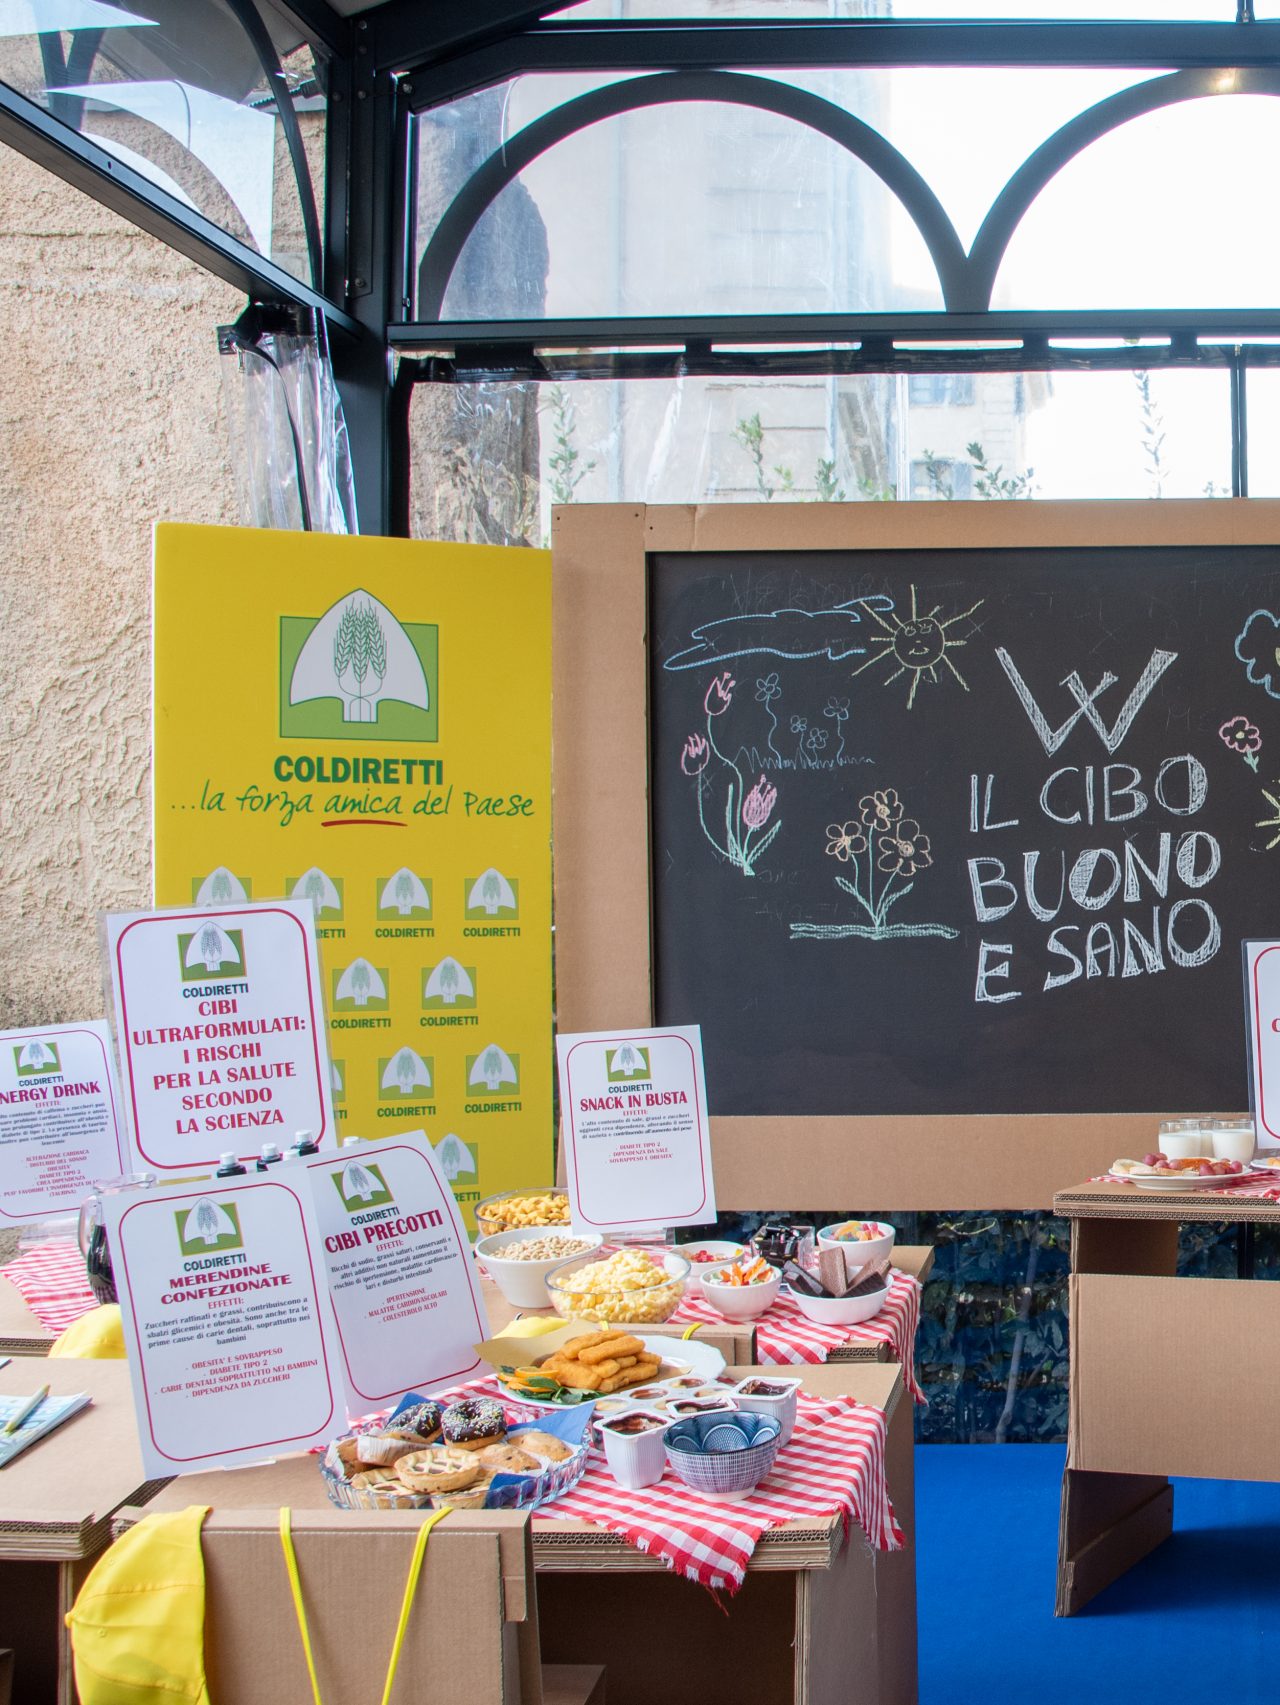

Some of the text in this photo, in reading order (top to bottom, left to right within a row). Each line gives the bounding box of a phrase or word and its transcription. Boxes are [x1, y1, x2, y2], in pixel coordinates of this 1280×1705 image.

[995, 647, 1178, 758] W
[273, 755, 444, 785] COLDIRETTI
[970, 753, 1208, 832] IL CIBO
[236, 784, 314, 827] forza
[324, 788, 403, 815] amica
[413, 784, 453, 815] del
[463, 791, 535, 817] Paese
[967, 830, 1220, 923] BUONO
[375, 927, 435, 938] COLDIRETTI
[463, 927, 521, 937] COLDIRETTI
[975, 898, 1221, 1003] E SANO
[183, 983, 249, 998] COLDIRETTI
[198, 999, 237, 1016] CIBI
[133, 1016, 306, 1046] ULTRAFORMULATI:
[331, 1018, 391, 1029] COLDIRETTI
[420, 1015, 479, 1027] COLDIRETTI
[183, 1043, 262, 1064] I RISCHI
[19, 1075, 64, 1087] COLDIRETTI
[153, 1062, 296, 1090] PER LA SALUTE
[0, 1081, 101, 1104] NERGY DRINK
[182, 1087, 273, 1111] SECONDO
[608, 1084, 652, 1094] COLDIRETTI
[377, 1105, 436, 1118] COLDIRETTI
[464, 1101, 522, 1114] COLDIRETTI
[580, 1091, 687, 1111] SNACK IN BUSTA
[176, 1109, 284, 1135] LA SCIENZA
[351, 1206, 400, 1225] COLDIRETTI
[325, 1210, 443, 1253] CIBI PRECOTTI
[184, 1253, 247, 1272] COLDIRETTI
[170, 1263, 272, 1288] MERENDINE
[161, 1274, 292, 1304] CONFEZIONATE
[145, 1318, 178, 1330] Zuccheri
[180, 1313, 211, 1323] raffinati
[247, 1299, 301, 1312] contribuiscono
[208, 1297, 244, 1309] EFFETTI:
[147, 1329, 169, 1338] sbalzi
[171, 1324, 205, 1336] glicemici
[265, 1310, 287, 1318] anche
[148, 1340, 170, 1349] prime
[257, 1318, 297, 1328] soprattutto
[217, 1334, 246, 1345] bambini
[234, 1348, 283, 1361] SOVRAPPESO
[161, 1384, 183, 1393] CARIE
[186, 1378, 216, 1389] DENTALI
[218, 1368, 271, 1383] SOPRATTUTTO
[287, 1360, 318, 1370] BAMBINI
[210, 1364, 241, 1375] DIABETE
[243, 1361, 261, 1369] TIPO
[192, 1383, 239, 1397] DIPENDENZA
[253, 1374, 290, 1386] ZUCCHERI
